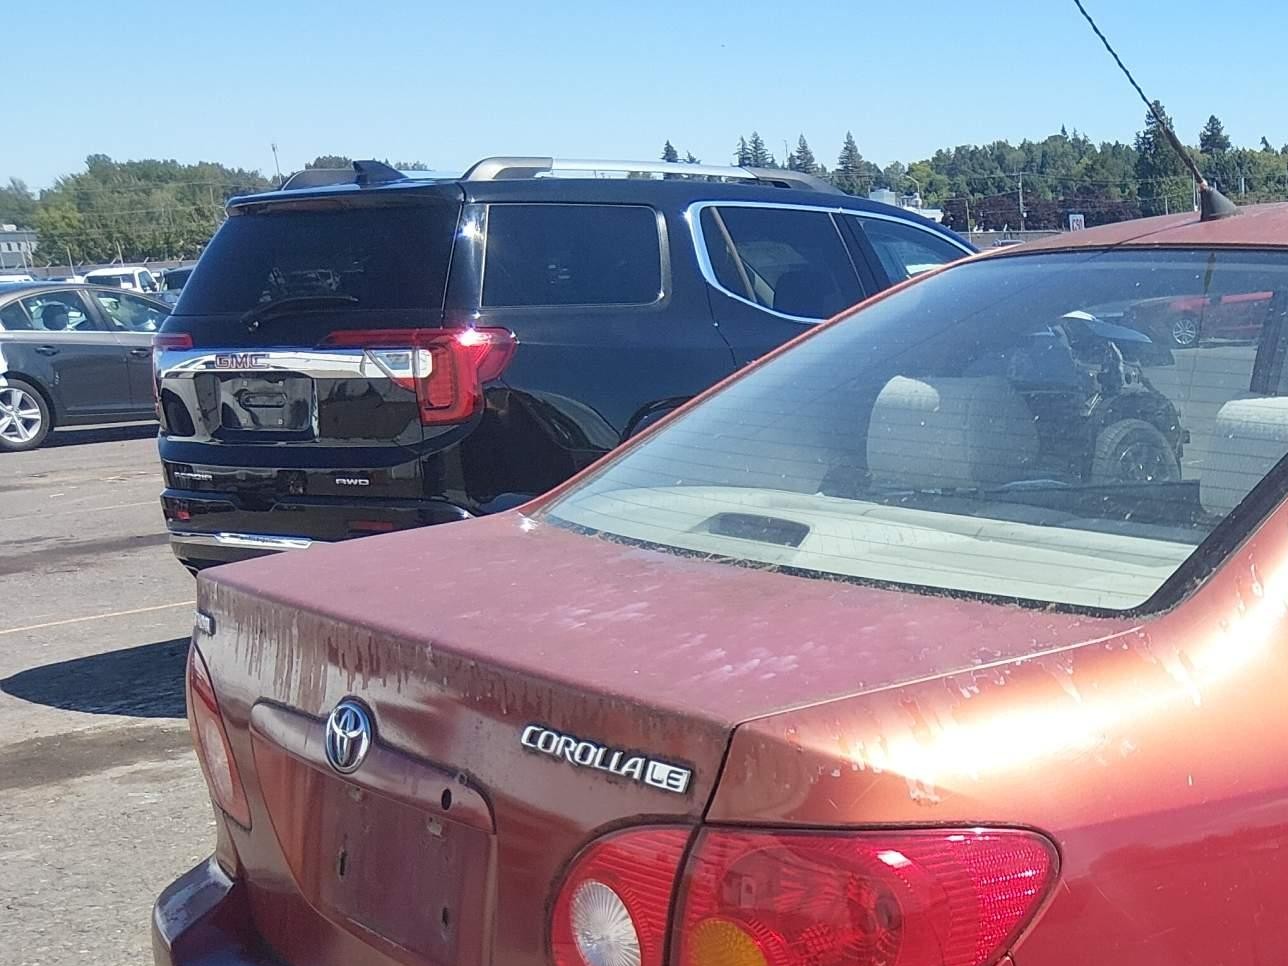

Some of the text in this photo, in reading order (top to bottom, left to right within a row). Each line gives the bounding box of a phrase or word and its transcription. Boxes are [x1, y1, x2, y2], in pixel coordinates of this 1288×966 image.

[215, 353, 270, 369] GMC
[335, 478, 369, 486] AWD
[521, 725, 689, 792] COROLLA LE
